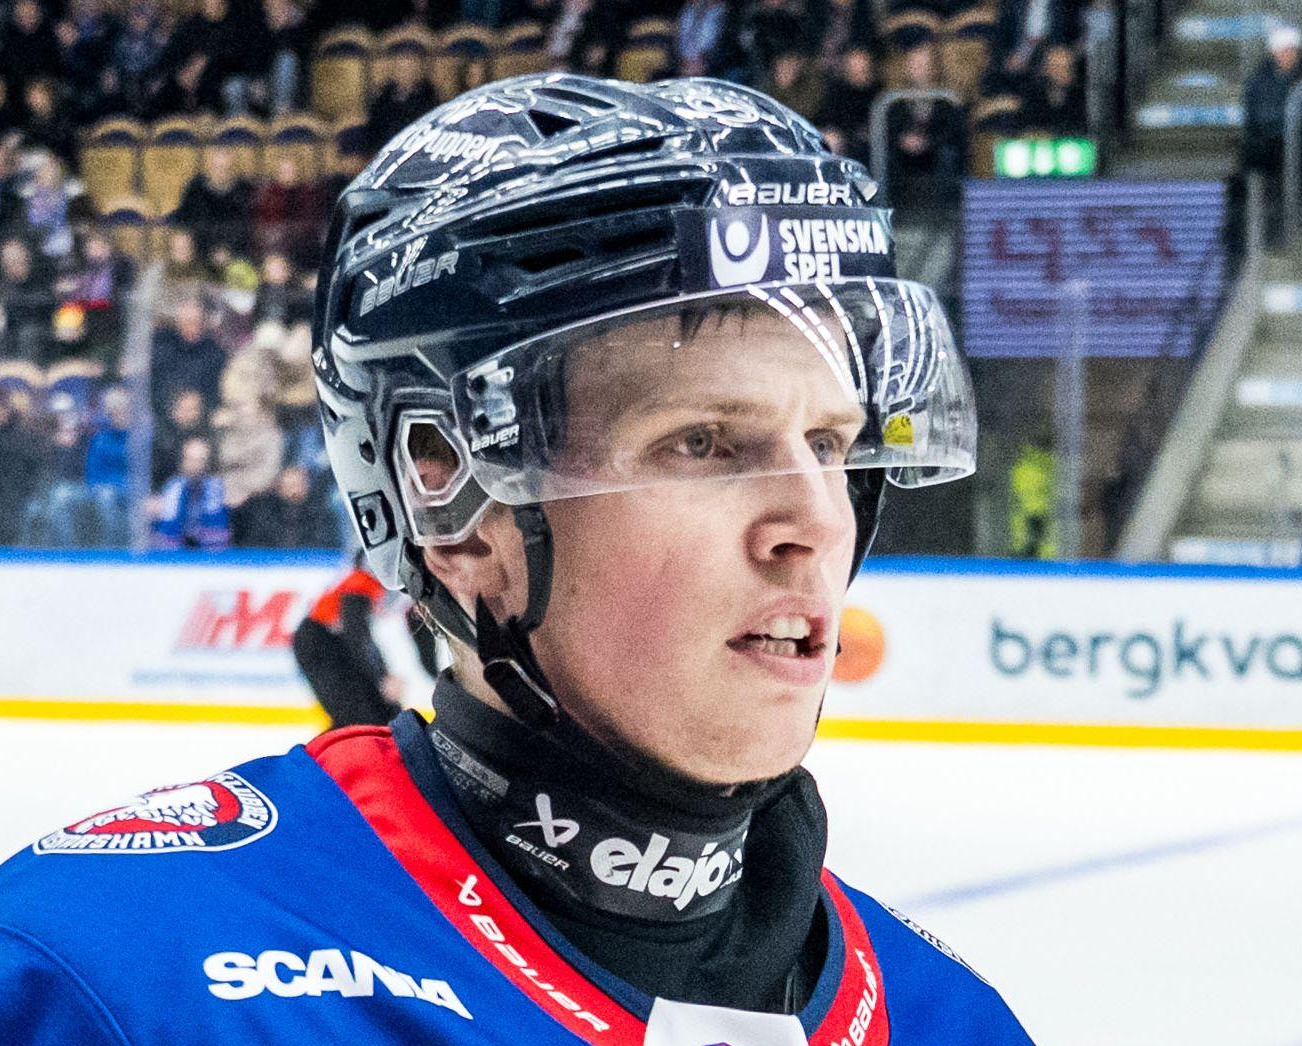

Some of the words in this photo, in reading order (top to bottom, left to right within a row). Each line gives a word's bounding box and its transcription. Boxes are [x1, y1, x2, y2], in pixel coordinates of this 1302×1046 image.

[778, 218, 889, 254] SVENSKA
[784, 253, 841, 284] SPEL
[590, 832, 731, 911] elajo
[203, 949, 474, 1020] SCANIA
